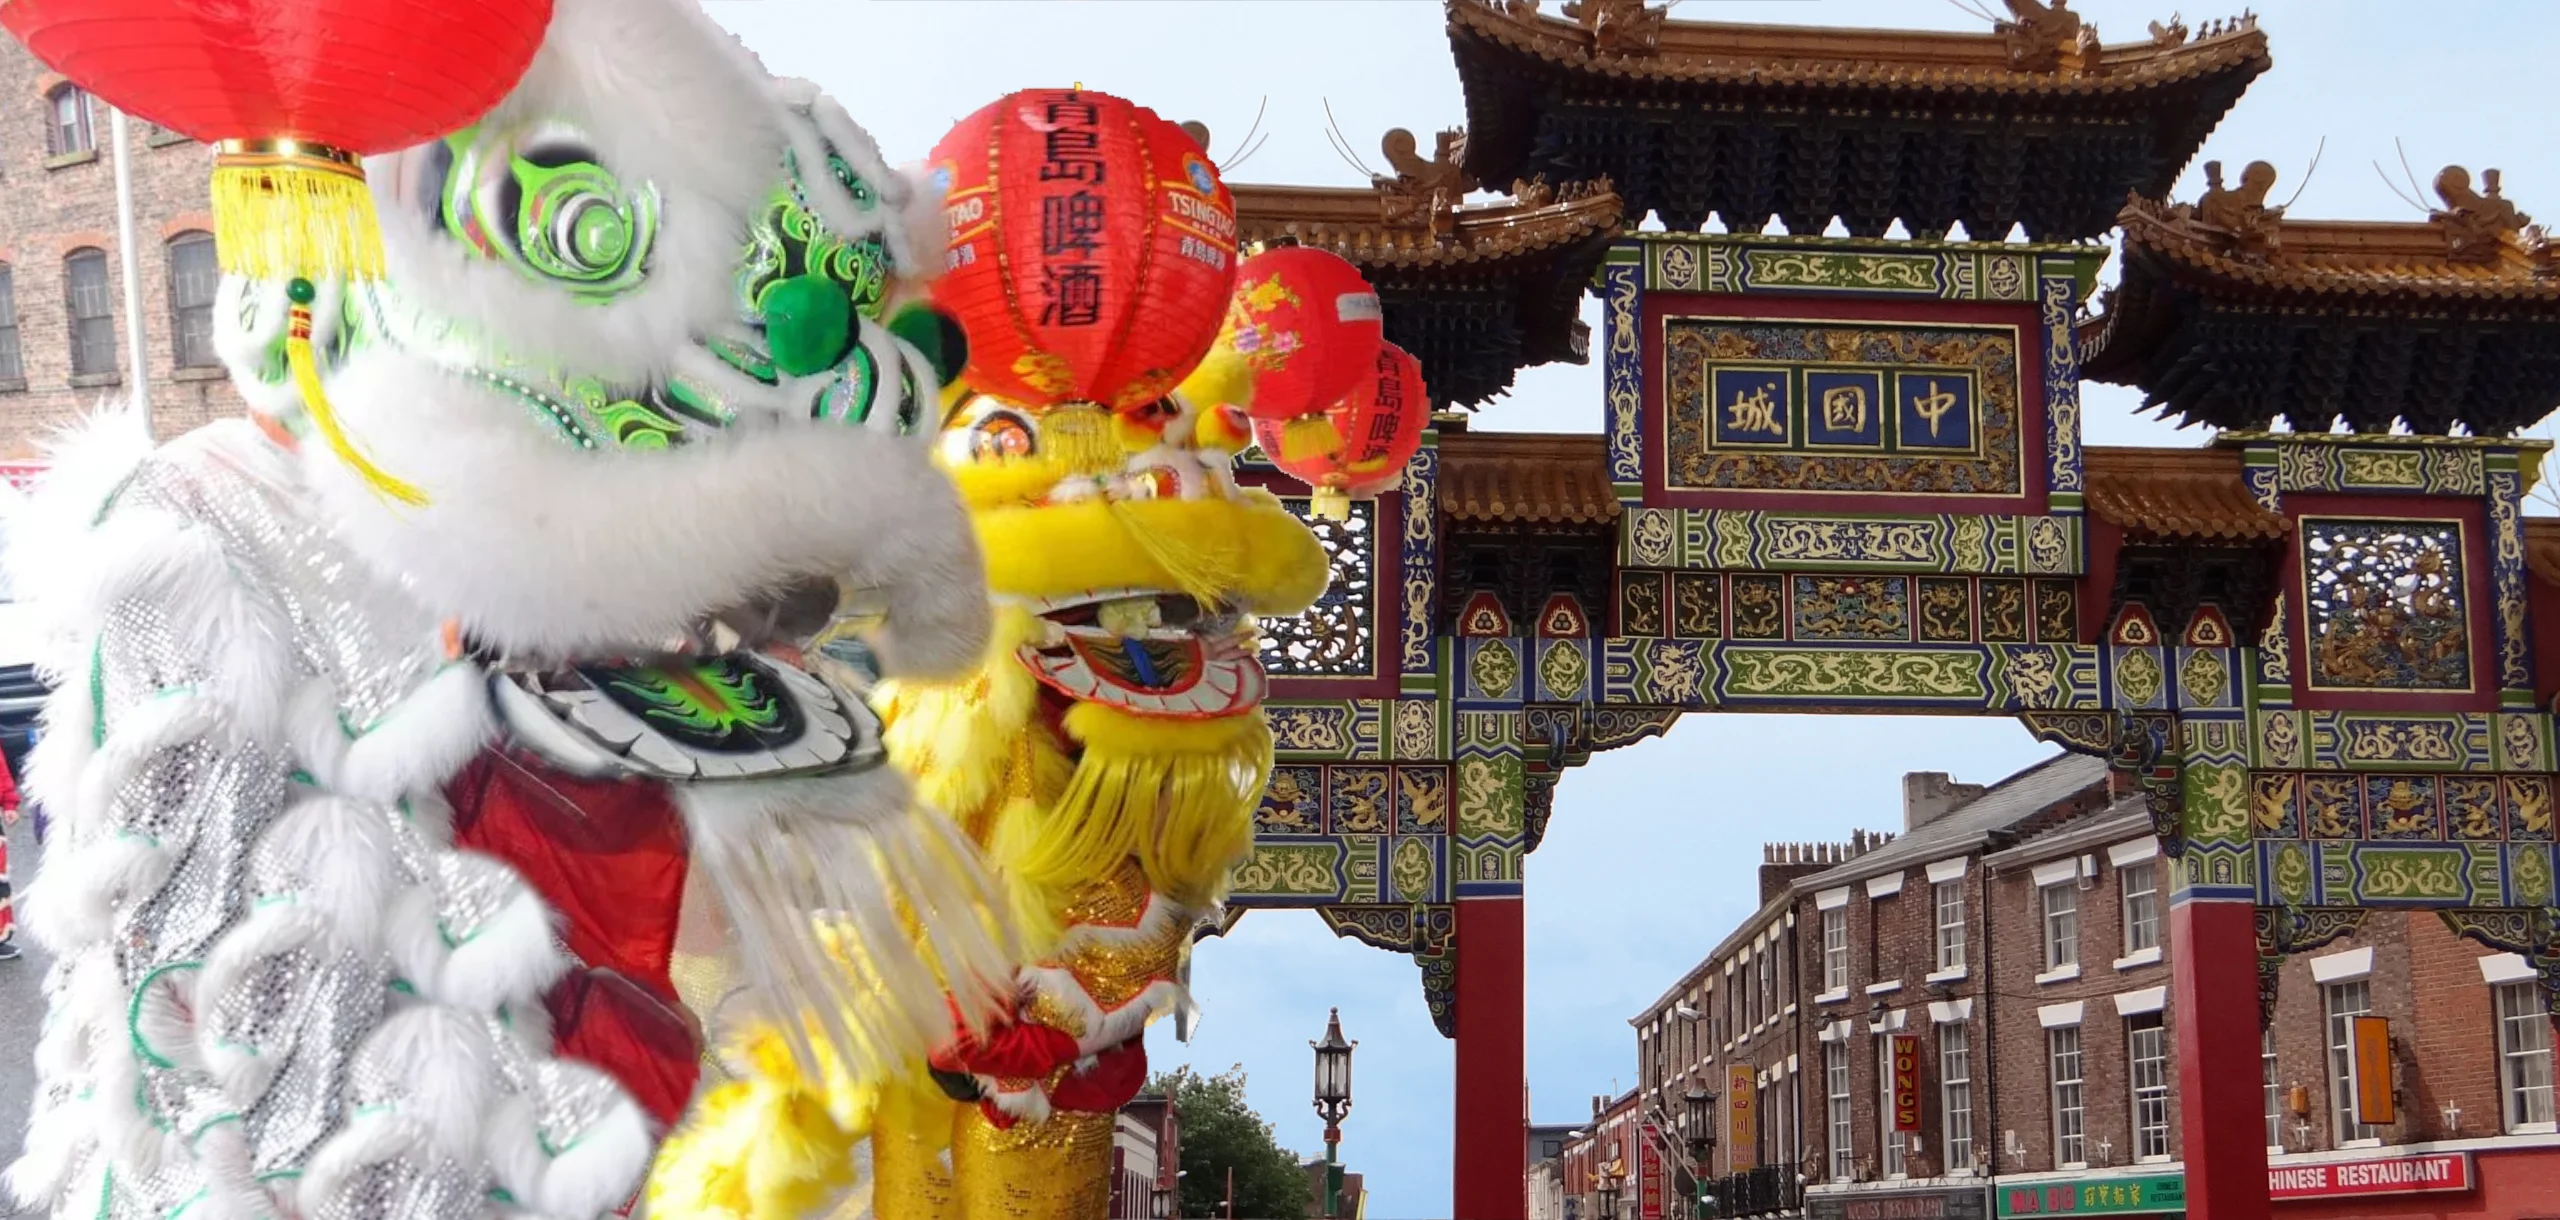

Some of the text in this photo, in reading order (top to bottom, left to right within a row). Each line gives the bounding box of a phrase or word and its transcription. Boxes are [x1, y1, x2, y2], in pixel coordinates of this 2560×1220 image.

[1038, 92, 1106, 327] 青島啤酒
[1167, 190, 1236, 238] TSINGTAO
[1732, 1074, 1749, 1136] 新四川
[1894, 1038, 1916, 1125] WONGS
[2009, 1188, 2041, 1214] MA
[2046, 1184, 2076, 1212] BO
[2268, 1158, 2451, 1190] HINESE RESTAURANT
